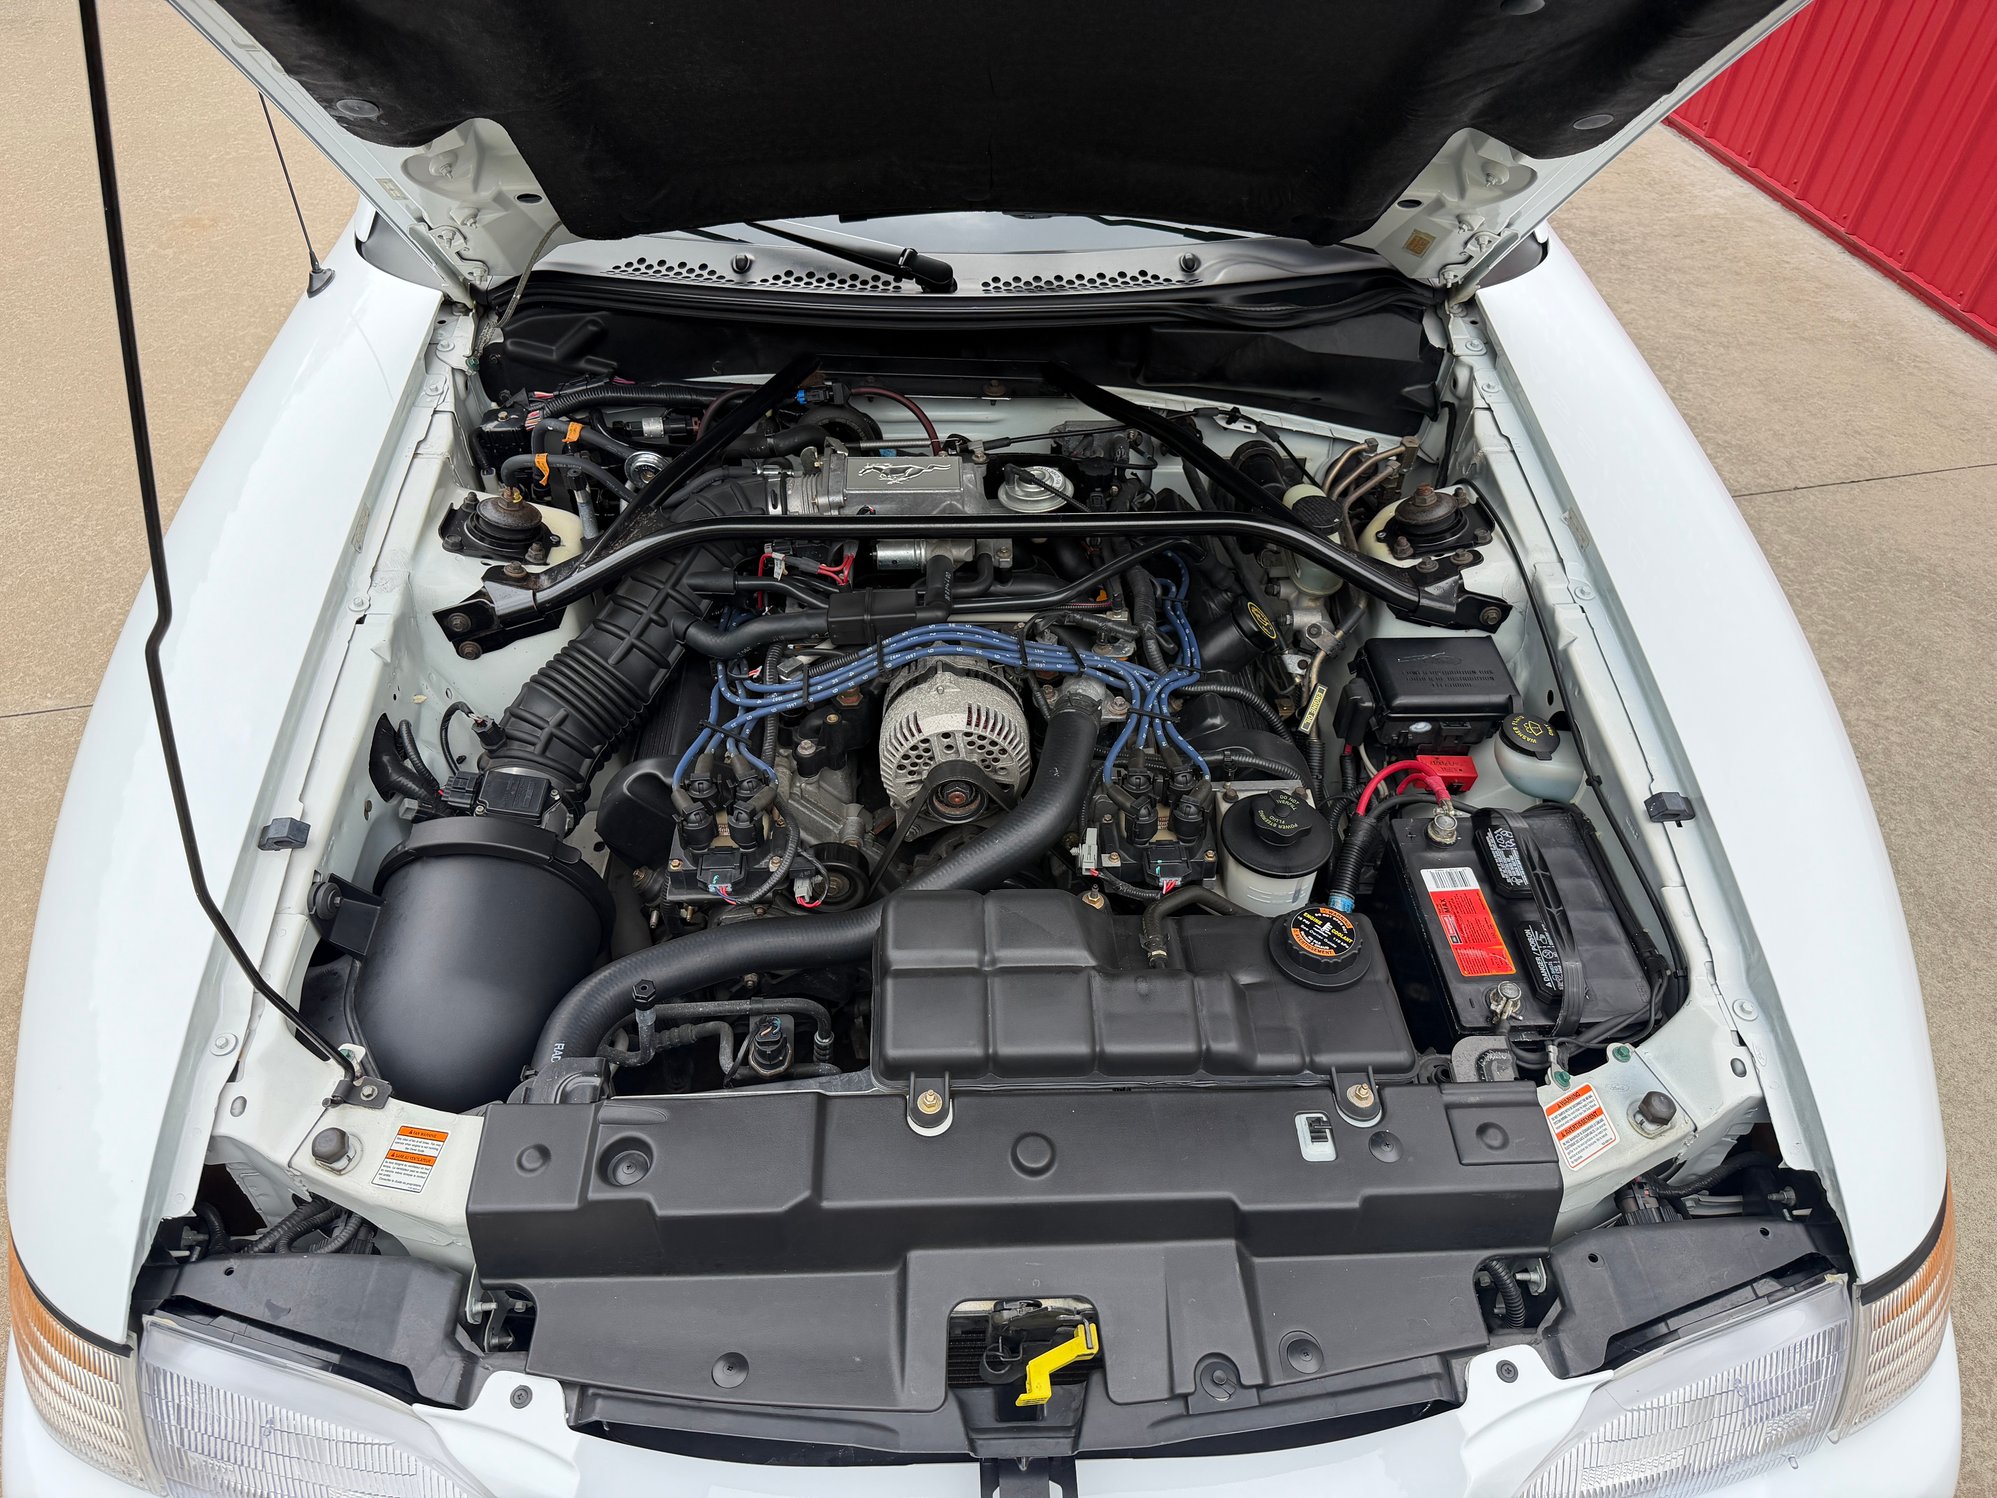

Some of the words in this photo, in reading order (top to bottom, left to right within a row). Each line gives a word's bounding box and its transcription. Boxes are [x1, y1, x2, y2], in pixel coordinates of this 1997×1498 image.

[1310, 691, 1323, 714] ENGINE
[1304, 713, 1314, 724] OIL
[1512, 726, 1537, 744] WASHER
[1288, 797, 1300, 805] NOT
[1269, 815, 1285, 824] FLUID
[1439, 899, 1450, 913] MAX
[1302, 912, 1323, 925] ENGINE
[1331, 928, 1354, 944] COOLANT
[1524, 928, 1539, 951] POISON
[1535, 956, 1551, 982] DANGER
[1565, 1111, 1599, 1136] AVERTISSEMENT
